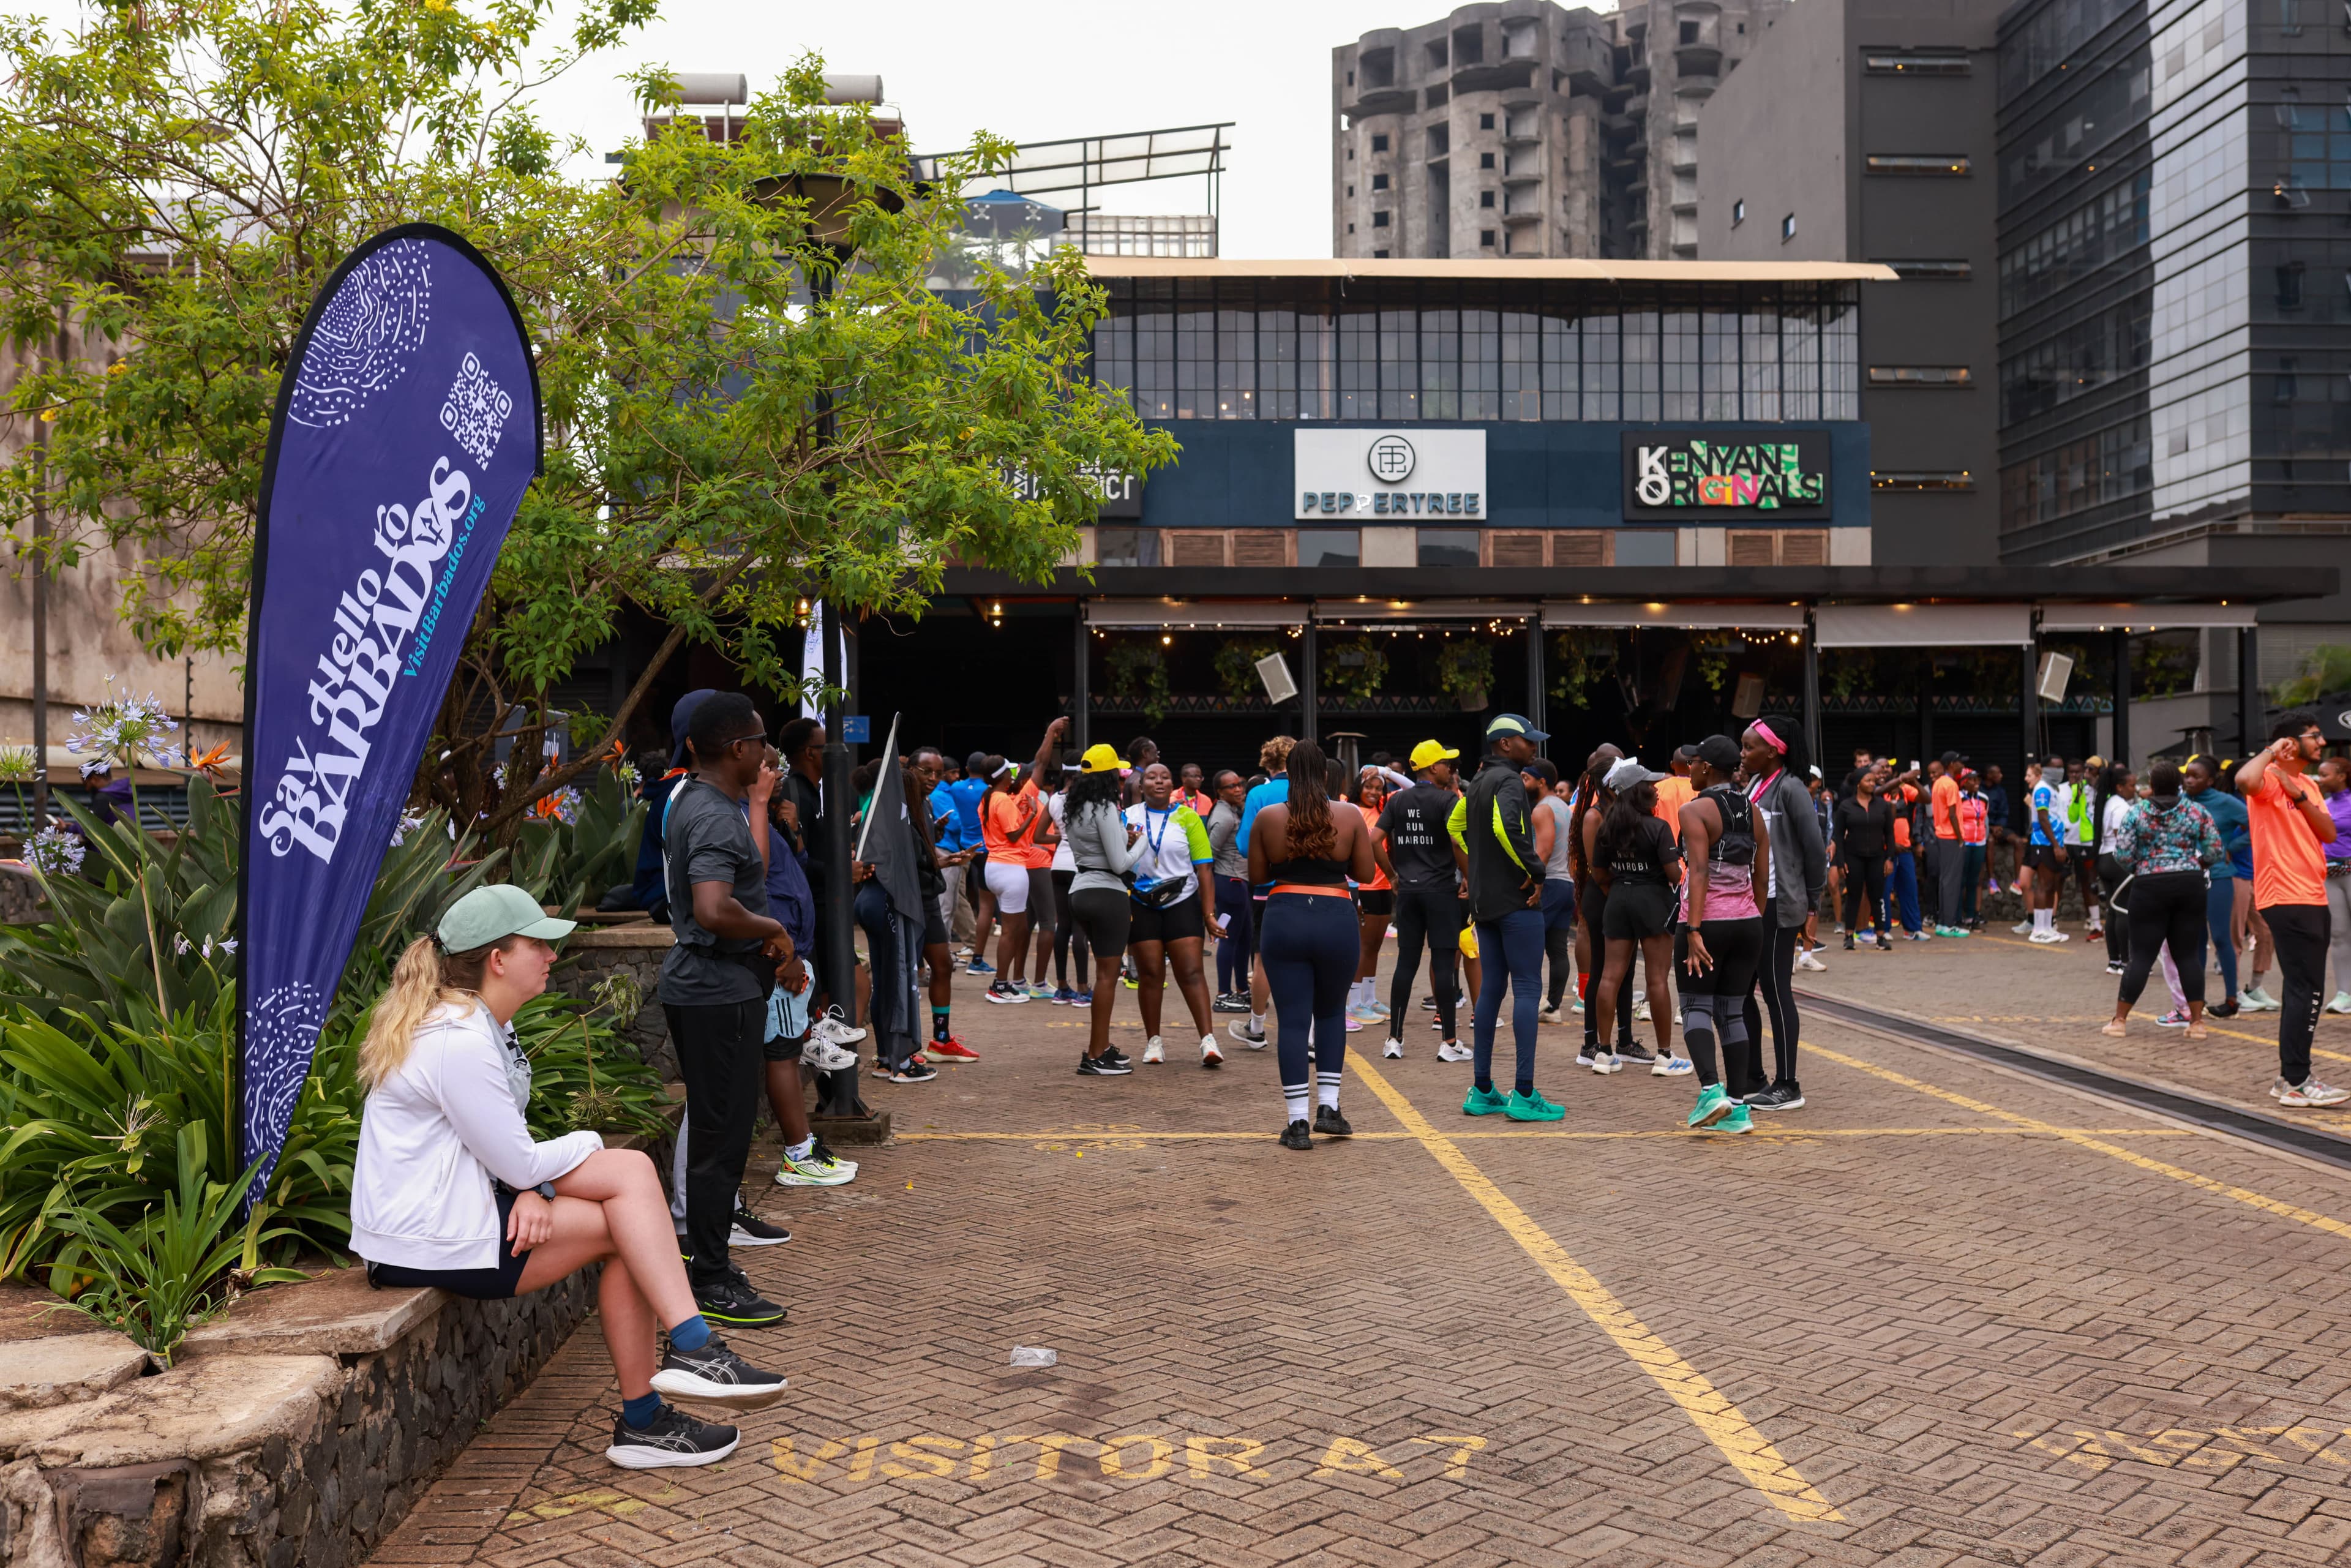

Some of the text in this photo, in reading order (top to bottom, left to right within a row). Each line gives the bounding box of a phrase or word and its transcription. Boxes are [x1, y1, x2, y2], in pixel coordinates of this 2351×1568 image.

[1303, 492, 1480, 514] PEPPERTREE
[403, 493, 486, 678] VisitBarbados.org
[259, 503, 410, 857] Say Hello to
[288, 456, 471, 865] BARBADOS
[1406, 822, 1424, 831] RUN
[1407, 808, 1421, 819] WE
[1397, 835, 1433, 845] NAIROBI
[2307, 991, 2321, 1032] TRAIN
[770, 1435, 1273, 1484] VISITOR
